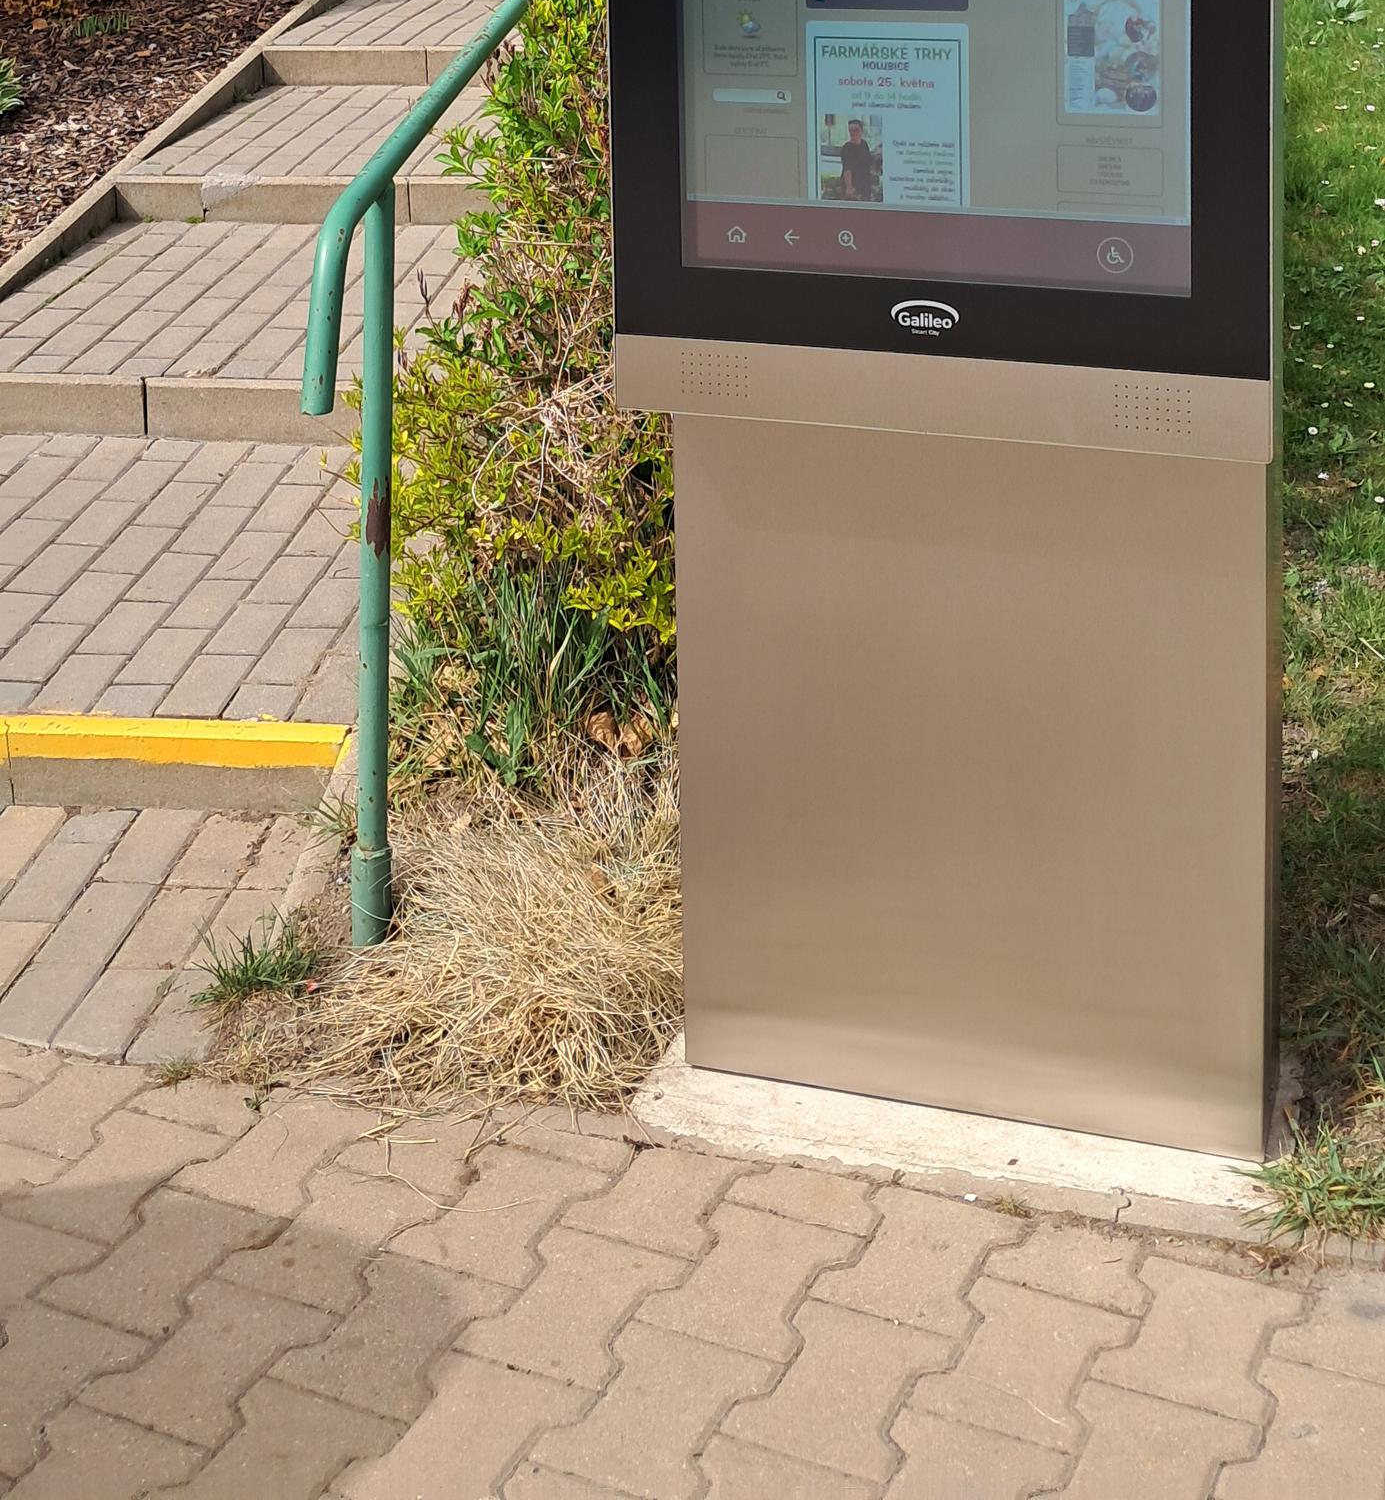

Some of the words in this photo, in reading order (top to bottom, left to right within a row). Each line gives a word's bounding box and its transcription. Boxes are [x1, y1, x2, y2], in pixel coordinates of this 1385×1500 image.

[821, 43, 908, 60] FARMÁŘSKÉ
[914, 47, 952, 61] TRHY
[862, 61, 910, 72] HOLUBICE
[838, 76, 874, 87] sobota
[877, 76, 896, 88] 25.
[900, 76, 935, 89] května
[898, 311, 953, 329] Galileo
